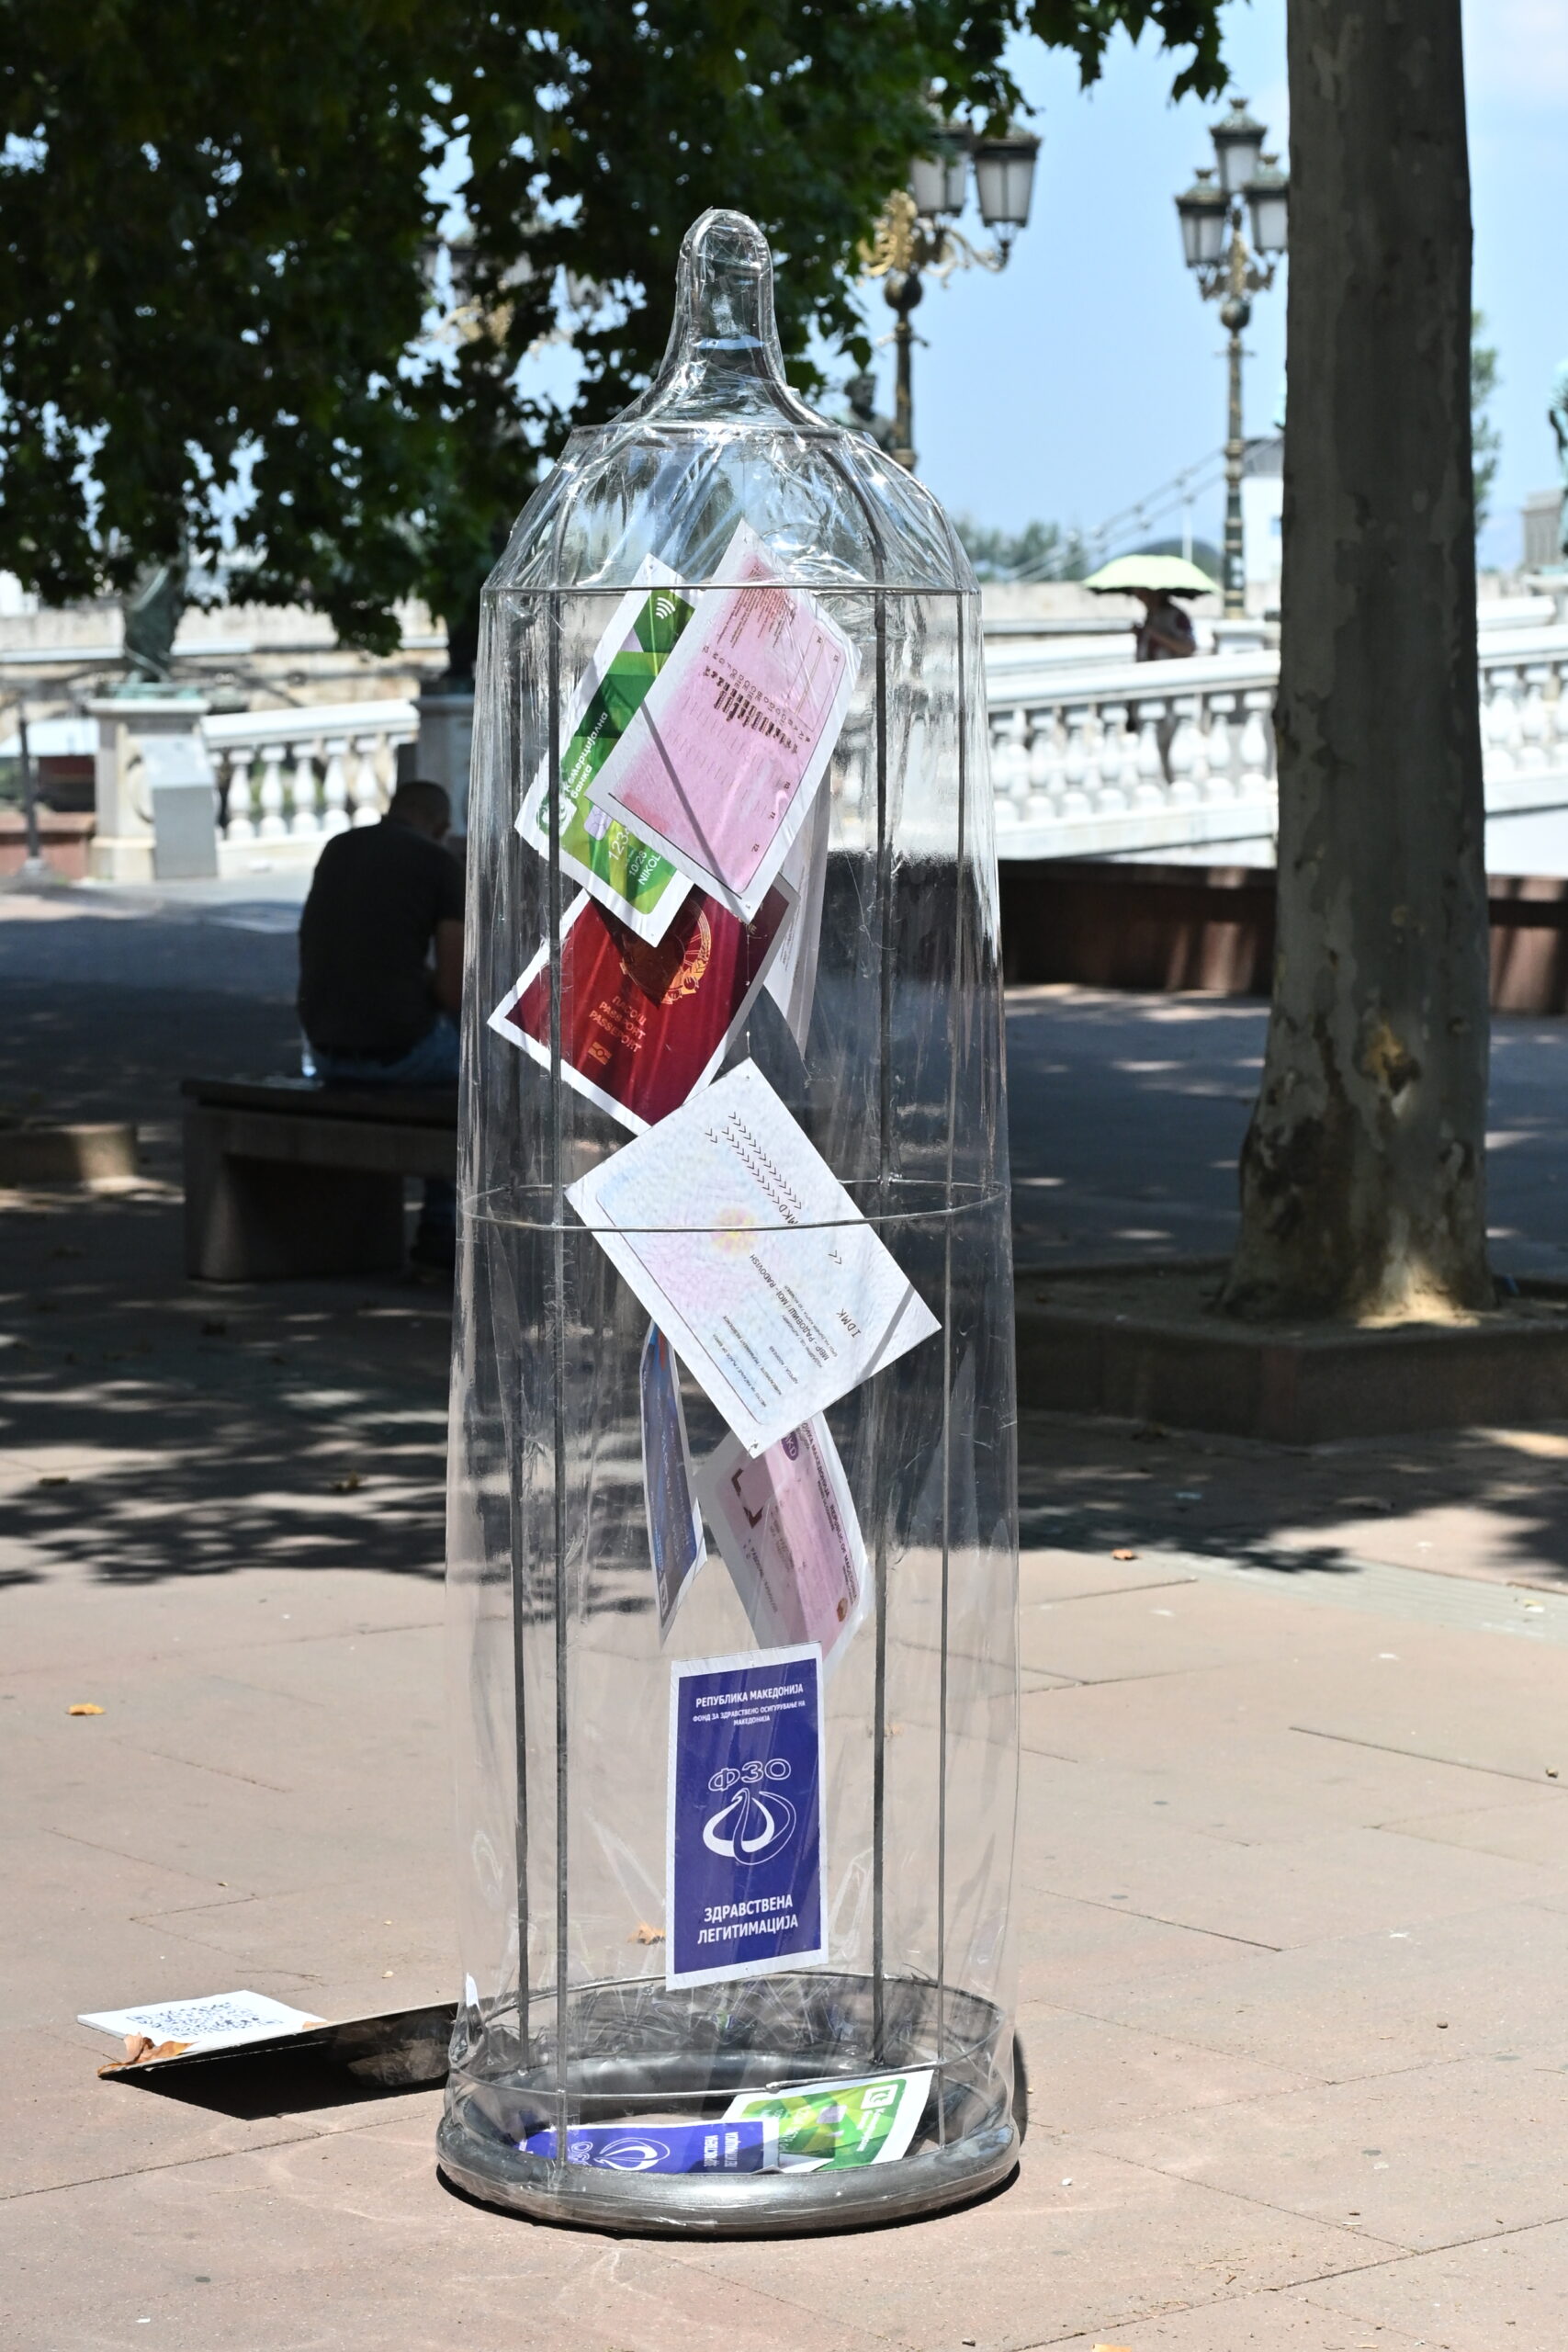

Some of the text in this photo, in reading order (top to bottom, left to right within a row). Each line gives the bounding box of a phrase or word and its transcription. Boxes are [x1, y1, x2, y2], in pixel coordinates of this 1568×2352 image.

[570, 763, 593, 799] банка
[589, 1010, 642, 1052] PASSEPORT
[599, 1001, 646, 1039] PASSPORT
[749, 1253, 776, 1288] RADOVISH
[774, 1289, 789, 1306] MOI
[787, 1306, 817, 1342] РАДОВИШ
[836, 1307, 862, 1338] IDMK
[814, 1343, 829, 1361] МВР
[695, 1683, 804, 1708] РЕПУБЛИКА МАКЕДОНИЈА
[693, 1713, 711, 1723] ФОНД
[712, 1713, 719, 1721] ЗА
[720, 1707, 759, 1720] ЗДРАВСТВЕНО
[760, 1702, 797, 1713] ОСИГУРУВАЊЕ
[733, 1714, 771, 1726] МАКЕДОНИЈА
[708, 1758, 792, 1792] ФЗО
[704, 1894, 794, 1923] ЗДРАВСТВЕНА
[697, 1914, 798, 1945] ЛЕГИТИМАЦИЈА
